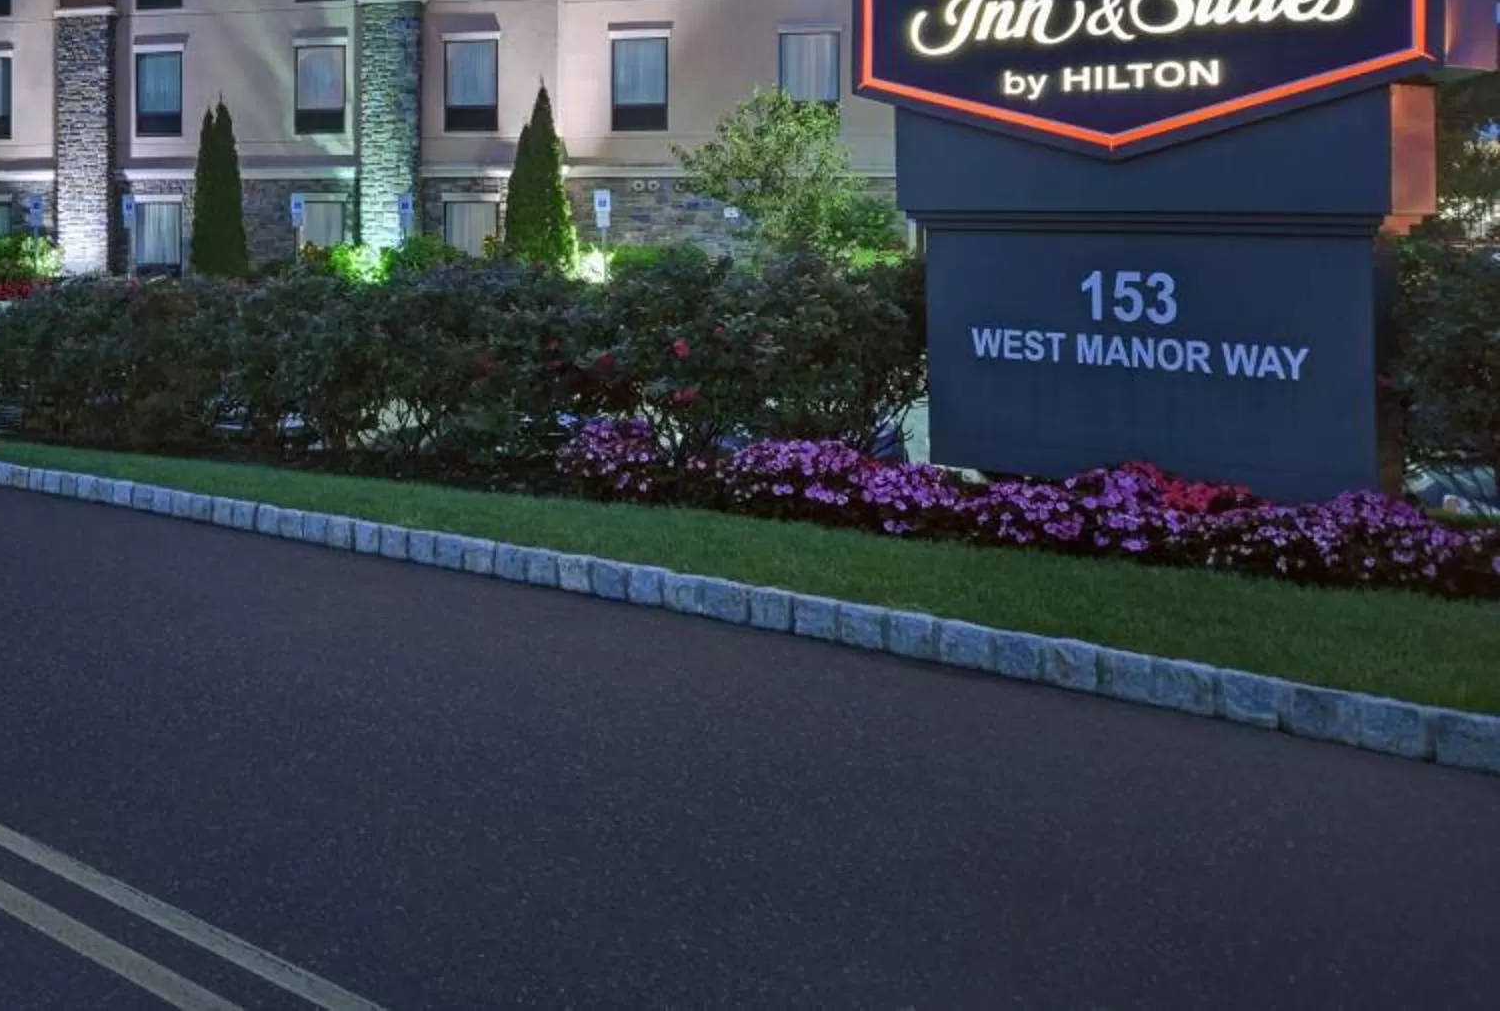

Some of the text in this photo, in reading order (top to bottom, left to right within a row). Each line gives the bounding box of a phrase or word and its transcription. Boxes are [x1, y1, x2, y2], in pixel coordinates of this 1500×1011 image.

[1004, 60, 1221, 99] by HILTON
[1080, 270, 1178, 324] 153
[971, 327, 1310, 381] WEST MANOR WAY
